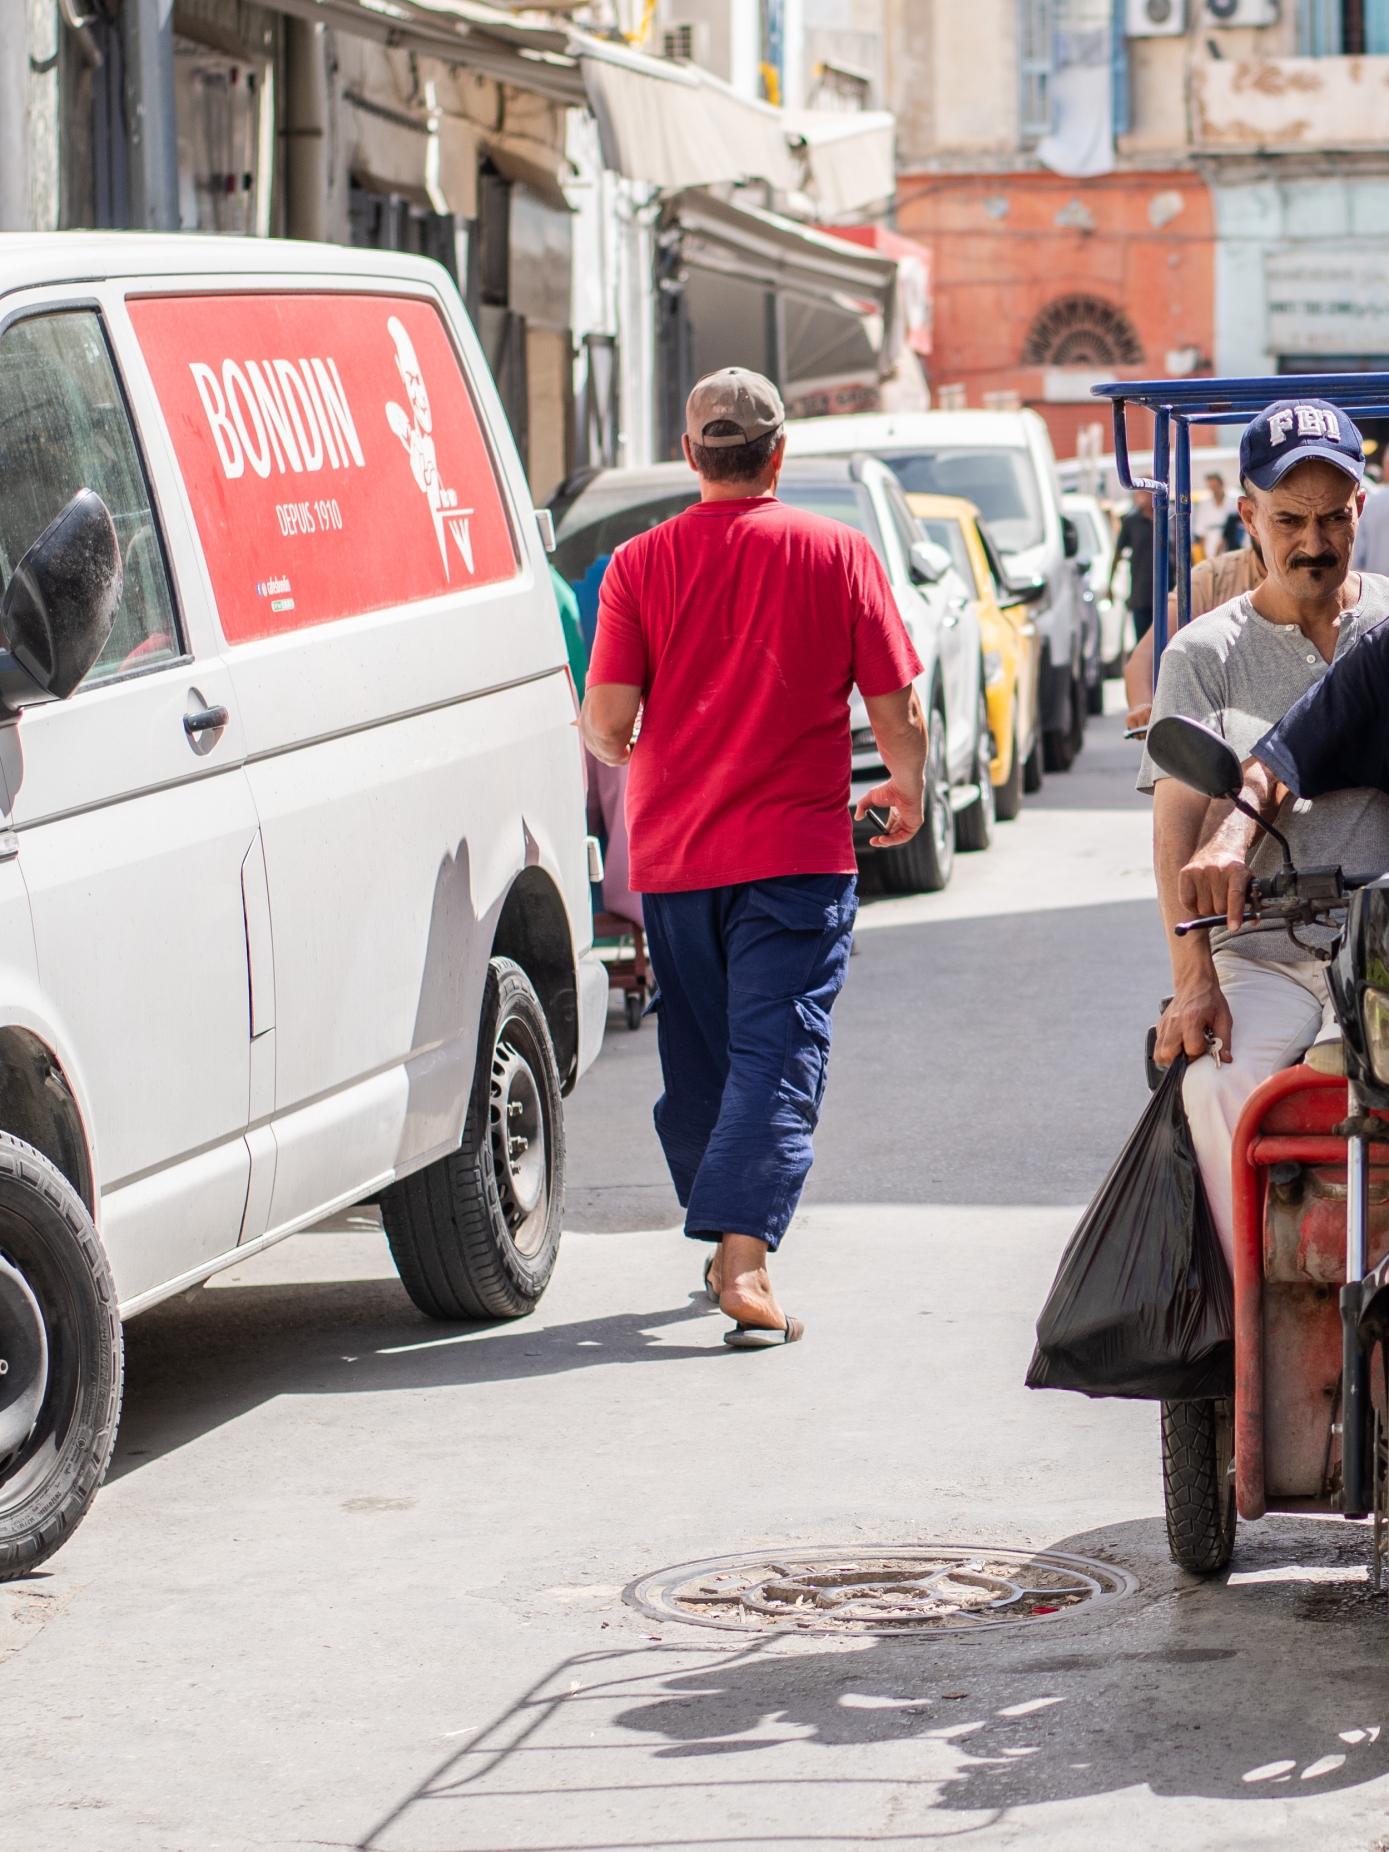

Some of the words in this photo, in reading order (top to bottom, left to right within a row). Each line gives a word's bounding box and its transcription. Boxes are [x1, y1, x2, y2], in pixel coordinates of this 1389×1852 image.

[189, 358, 365, 479] BONDIN
[713, 405, 735, 414] NIKE
[1267, 405, 1341, 447] FBI
[276, 501, 315, 537] DEPUIS
[314, 499, 343, 533] 1910
